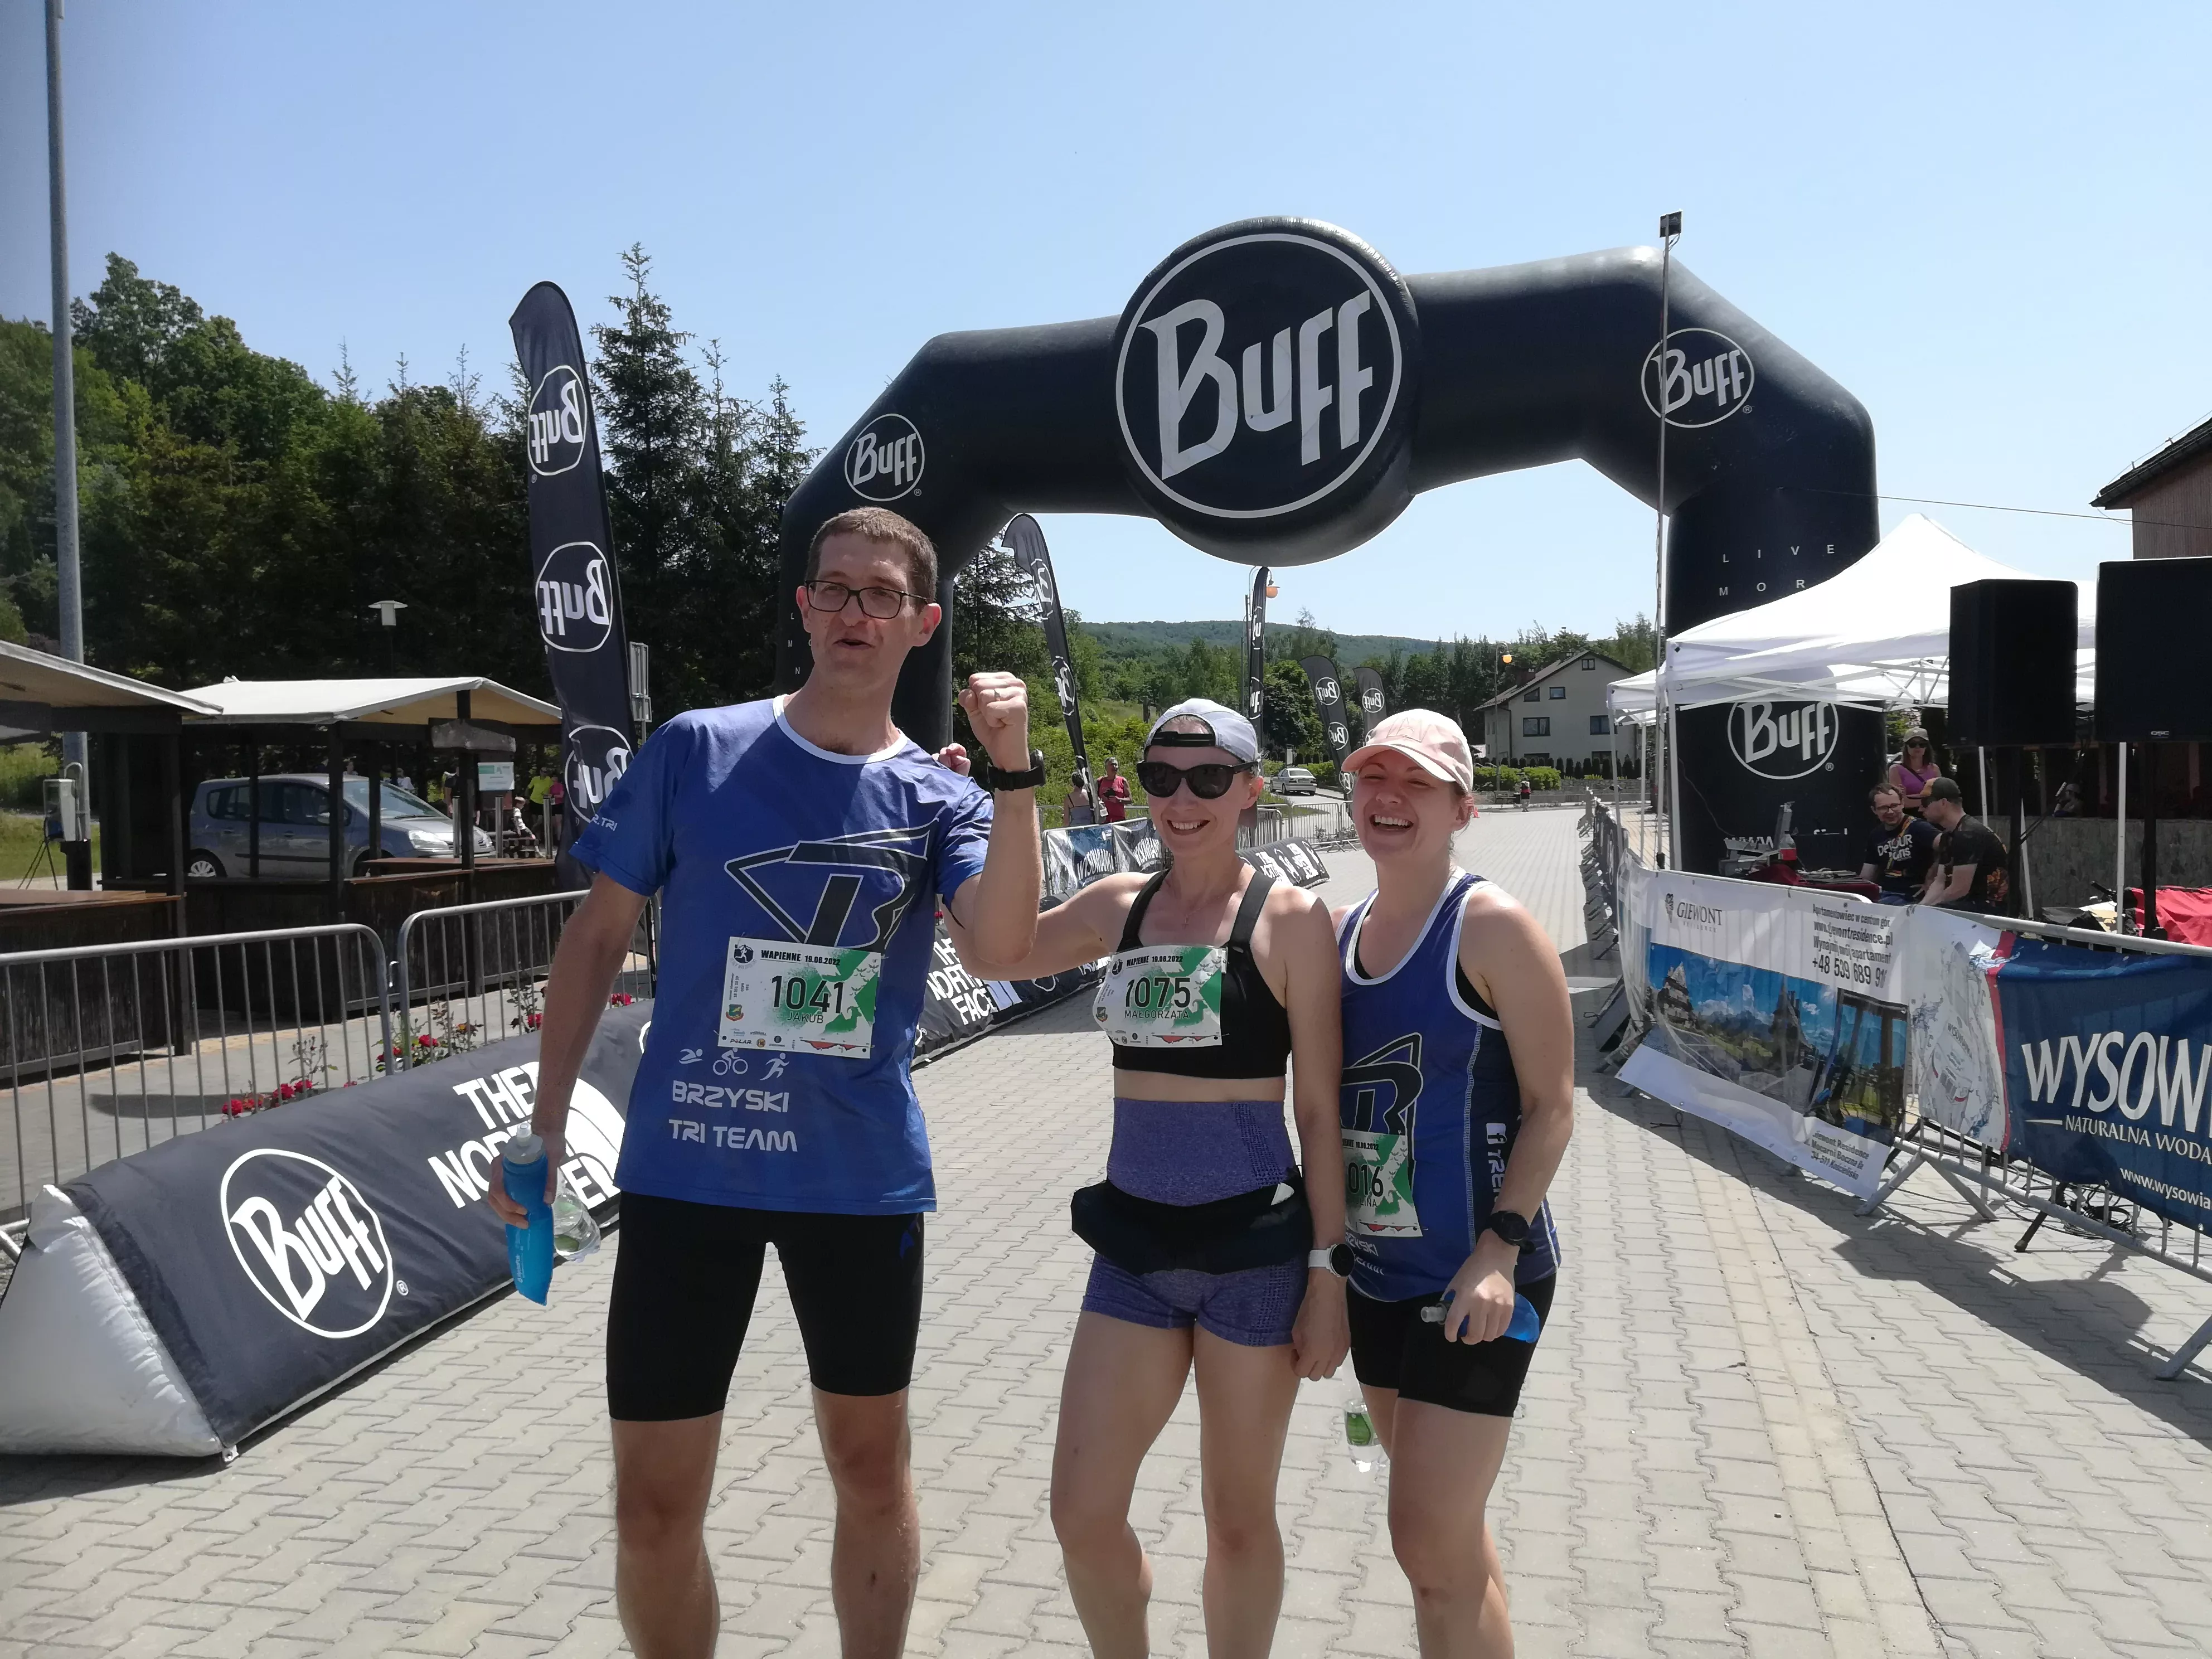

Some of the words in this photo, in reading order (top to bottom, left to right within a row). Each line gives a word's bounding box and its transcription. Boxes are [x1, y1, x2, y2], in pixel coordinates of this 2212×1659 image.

[1138, 289, 1373, 480] Buff
[1651, 350, 1745, 415] Buff
[853, 433, 918, 486] Buff
[1719, 579, 1805, 596] MOR
[1737, 702, 1830, 763] Buff
[1677, 902, 1723, 926] GIEWONT
[761, 949, 801, 962] WAPIENNE
[804, 955, 841, 966] 19.06.2022
[1127, 955, 1149, 967] WAPIENNE
[1812, 954, 1830, 974] +48
[1834, 957, 1850, 979] 539
[1853, 963, 1871, 985] 689
[771, 975, 845, 1014] 1041
[1126, 977, 1191, 1008] 1075
[787, 1012, 824, 1024] JAKUB
[1124, 1010, 1189, 1019] MAŁGORZATA
[672, 1080, 789, 1113] BRZYSKI
[669, 1119, 705, 1143] TRI
[712, 1126, 798, 1152] TEAM
[2065, 1115, 2151, 1147] NATURALNA
[2155, 1133, 2212, 1165] WODA
[1348, 1162, 1384, 1197] 016
[230, 1176, 385, 1321] Buff
